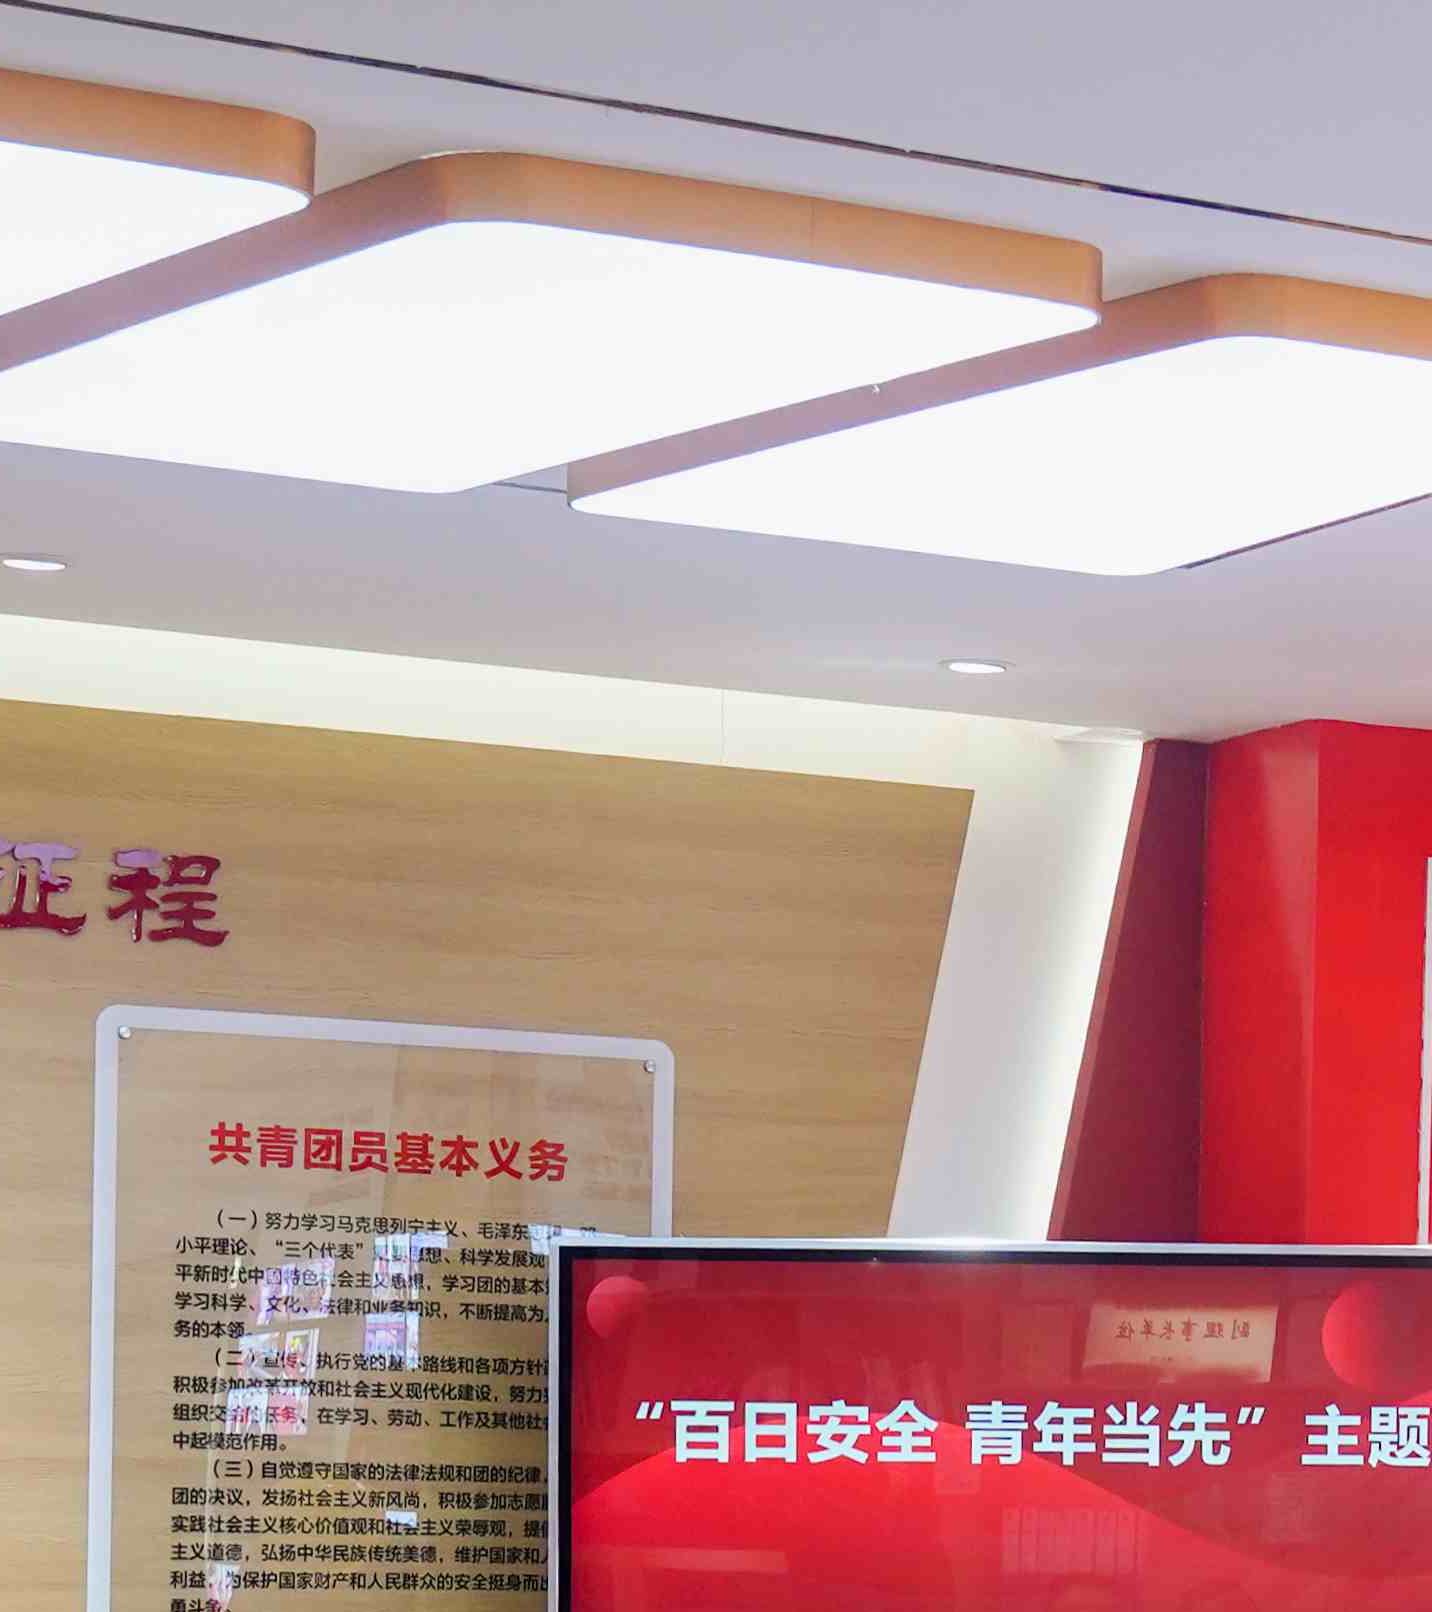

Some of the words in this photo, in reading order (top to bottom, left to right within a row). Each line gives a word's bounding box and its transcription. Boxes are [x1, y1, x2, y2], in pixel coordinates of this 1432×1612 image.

[209, 1121, 569, 1182] 共青团员基本义务
[217, 1208, 596, 1241] （一）努力学习马克思列宁主义、毛泽东
[175, 1236, 545, 1268] 小平理论、“三个代表”想、科学发展观
[175, 1263, 550, 1295] 平新时代中国特色社会主义思想，学习团的基本
[174, 1291, 550, 1323] 学习科学、文化、法律和业务知识，不断提高为
[633, 1398, 938, 1464] “百日安全
[964, 1401, 1267, 1467] 青年当先”
